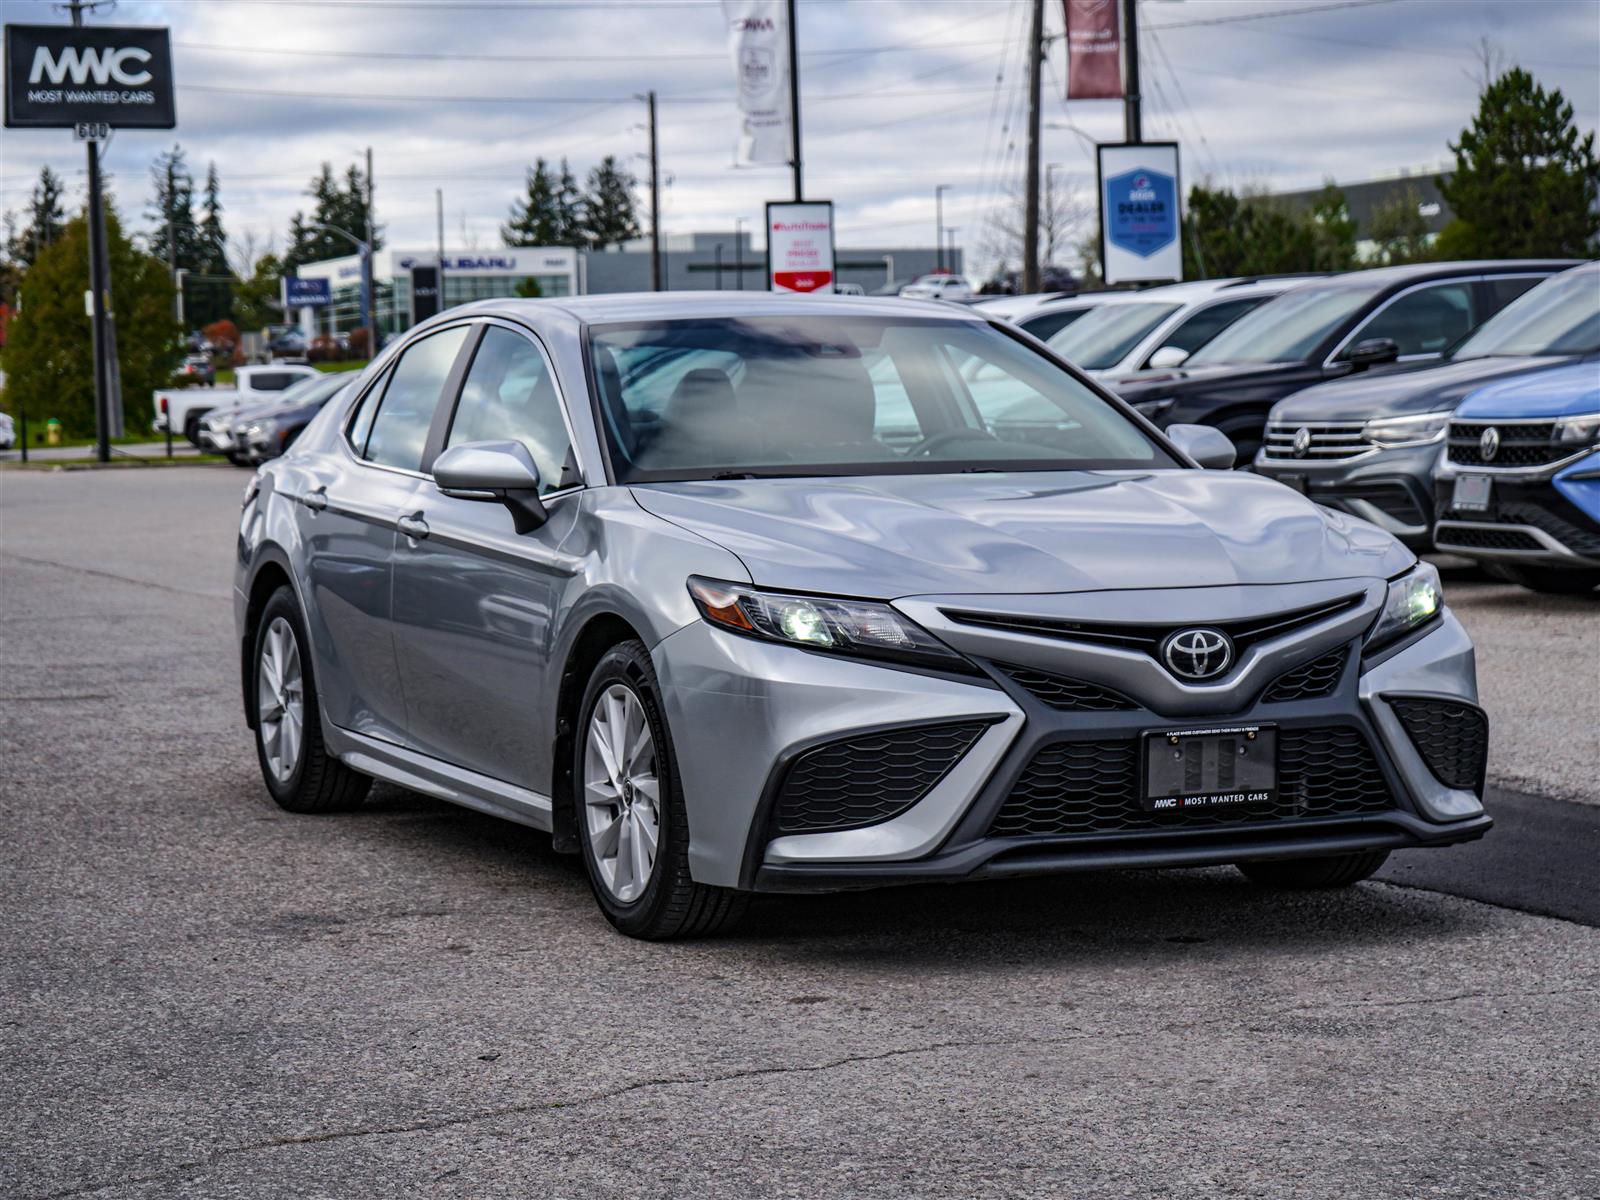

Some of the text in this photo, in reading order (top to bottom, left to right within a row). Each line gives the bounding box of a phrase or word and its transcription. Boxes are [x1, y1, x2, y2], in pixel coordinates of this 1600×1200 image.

[28, 45, 153, 86] MWC
[28, 90, 155, 104] MOST WANTED CARS
[78, 124, 108, 138] 600
[440, 257, 516, 269] SUBARU
[1155, 792, 1268, 808] MWC MOST WANTED CARS
